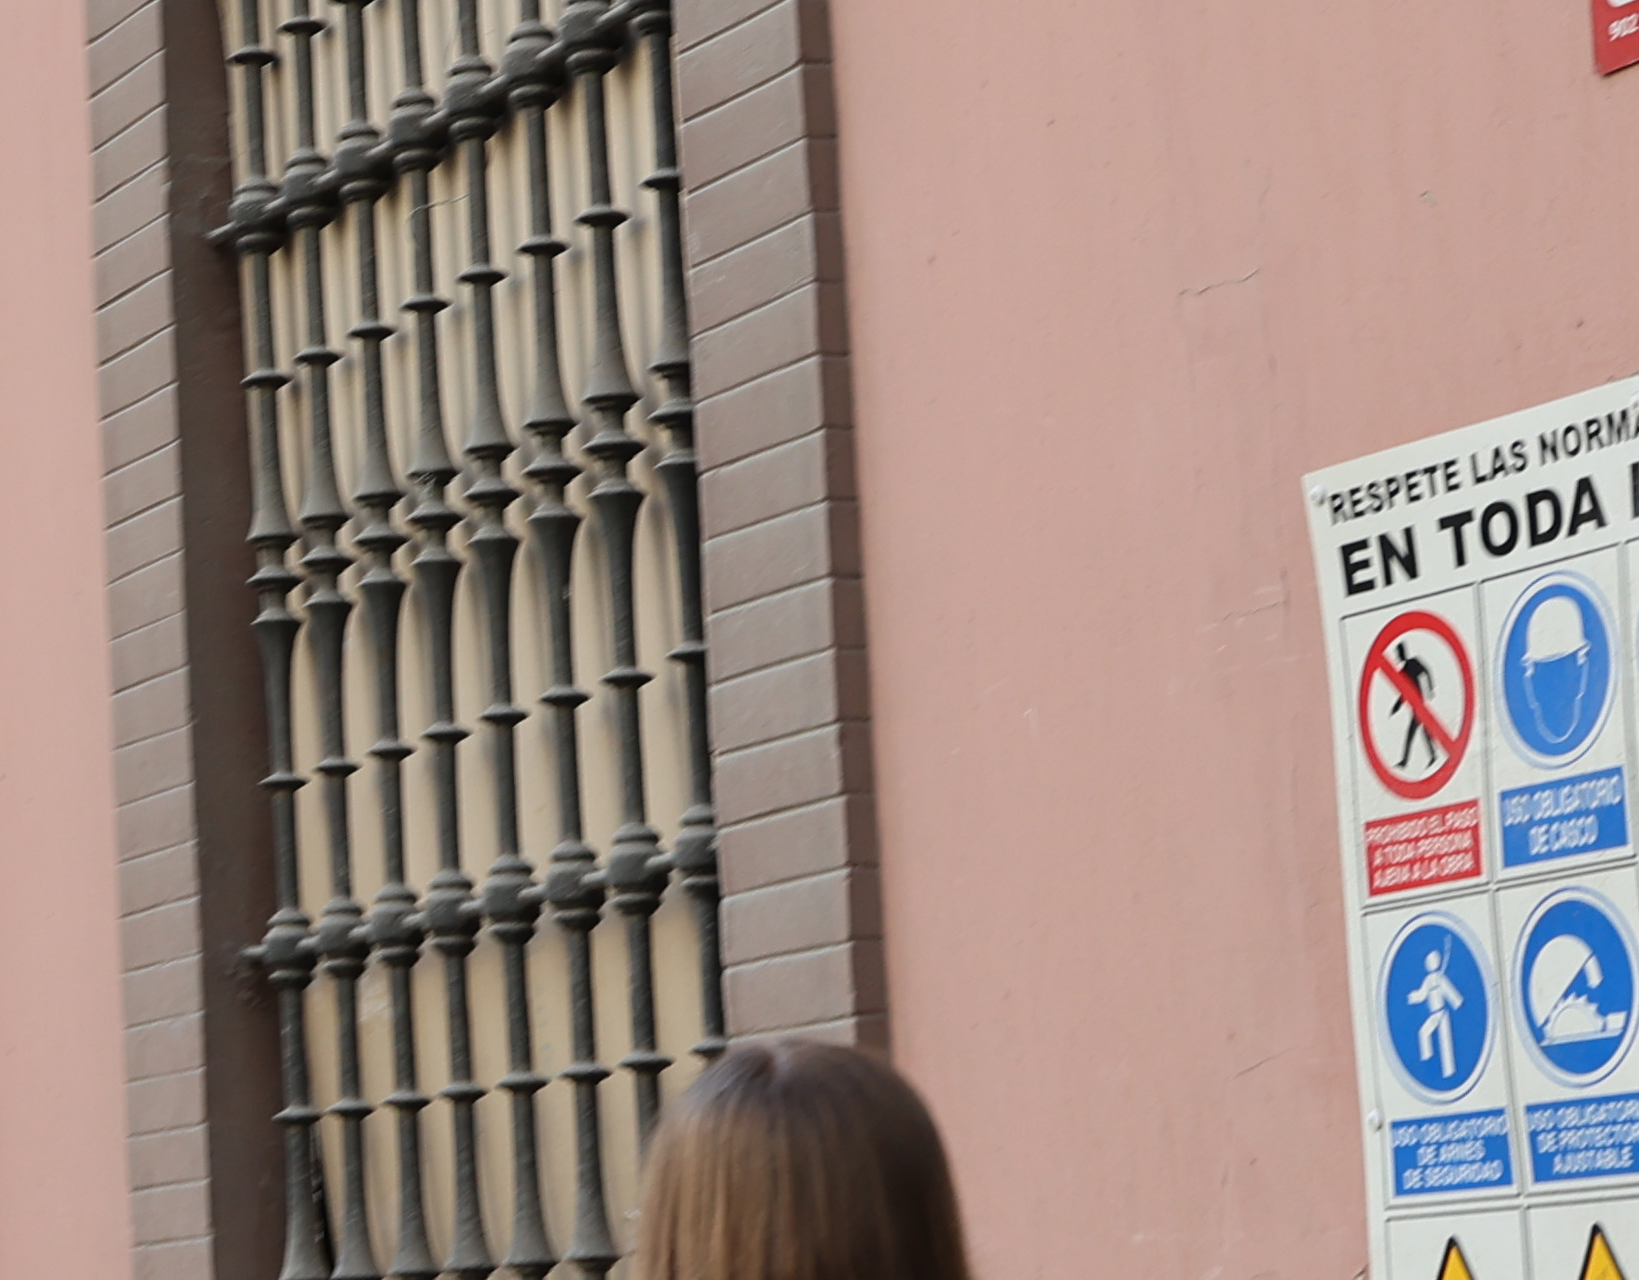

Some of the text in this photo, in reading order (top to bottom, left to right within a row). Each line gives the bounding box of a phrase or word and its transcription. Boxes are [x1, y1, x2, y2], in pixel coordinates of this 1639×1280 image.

[1470, 440, 1528, 486] LAS
[1339, 525, 1419, 596] EN
[1438, 475, 1607, 568] TODA
[1529, 825, 1548, 856] DE
[1417, 1144, 1436, 1166] DE
[1538, 1133, 1556, 1154] DE
[1403, 1169, 1422, 1190] DE
